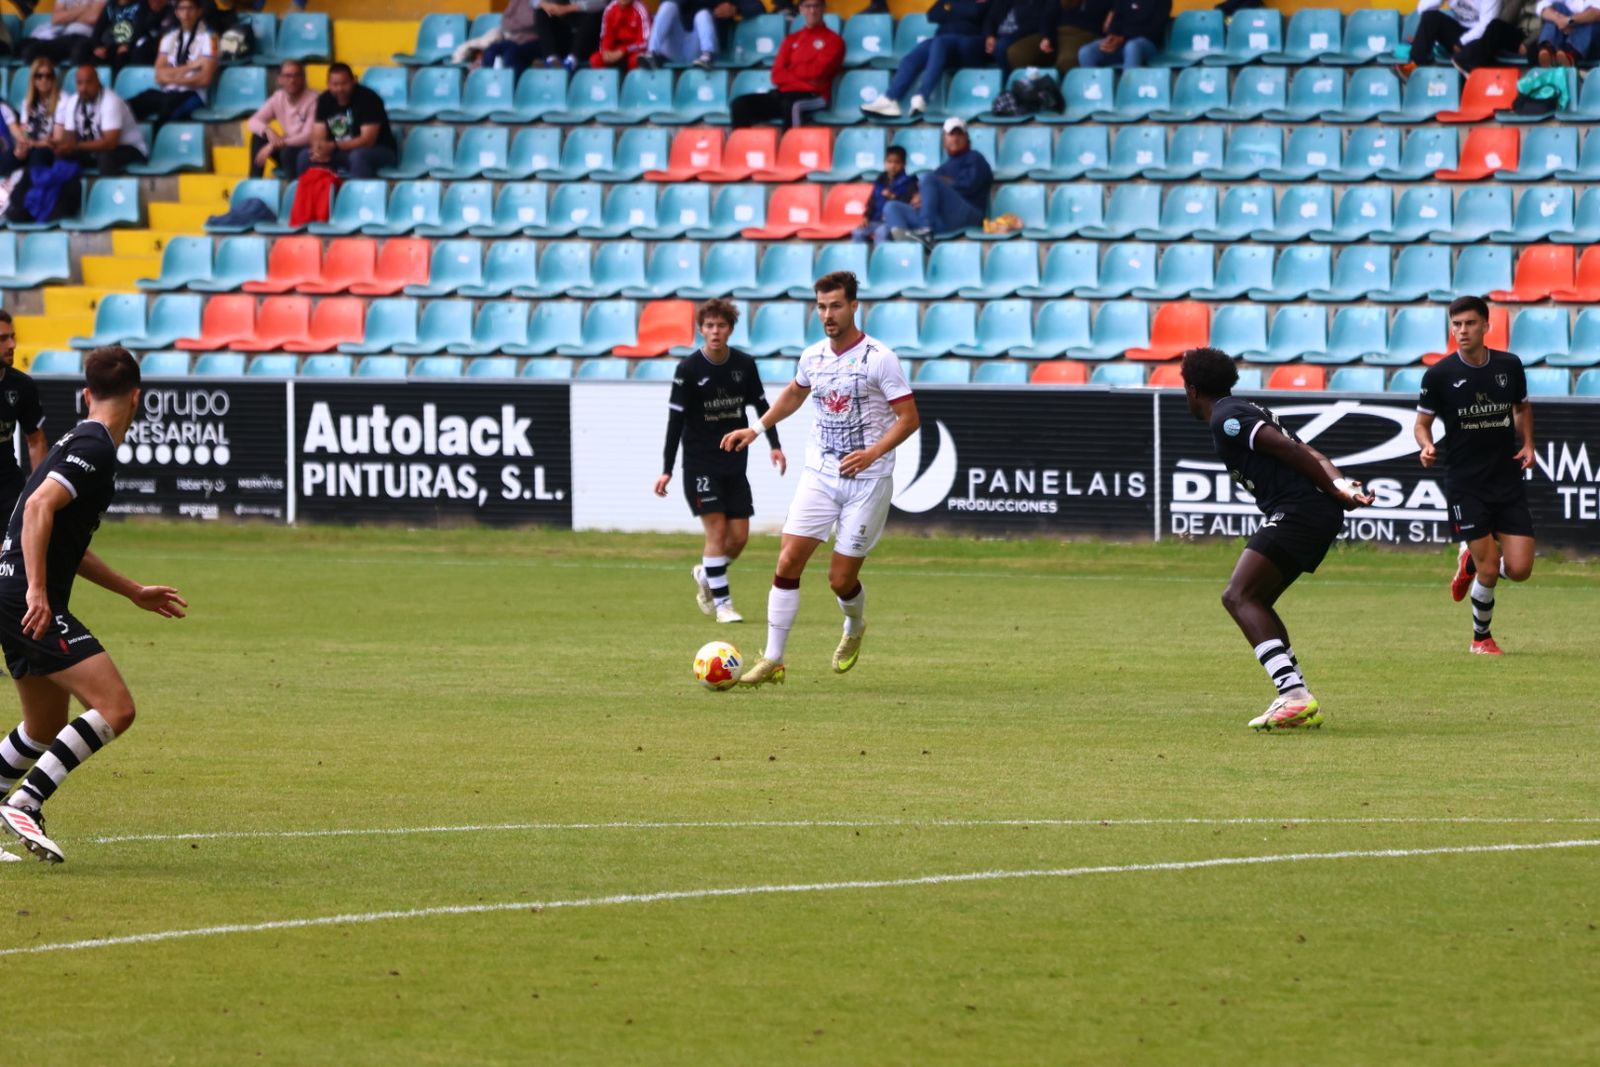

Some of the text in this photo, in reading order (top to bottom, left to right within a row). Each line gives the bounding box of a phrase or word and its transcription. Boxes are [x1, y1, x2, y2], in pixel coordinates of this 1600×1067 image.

[144, 389, 230, 422] grupo
[125, 421, 230, 445] RESARIAL
[303, 401, 534, 457] Autolack
[302, 461, 489, 507] PINTURAS,
[501, 464, 565, 501] S.L.
[696, 475, 711, 493] 22
[968, 467, 1147, 498] PANELAIS
[947, 498, 1058, 514] PRODUCCIONES
[1557, 487, 1600, 520] TE
[1171, 513, 1205, 535] DE
[1408, 521, 1453, 543] S.L.
[55, 614, 69, 635] 5
